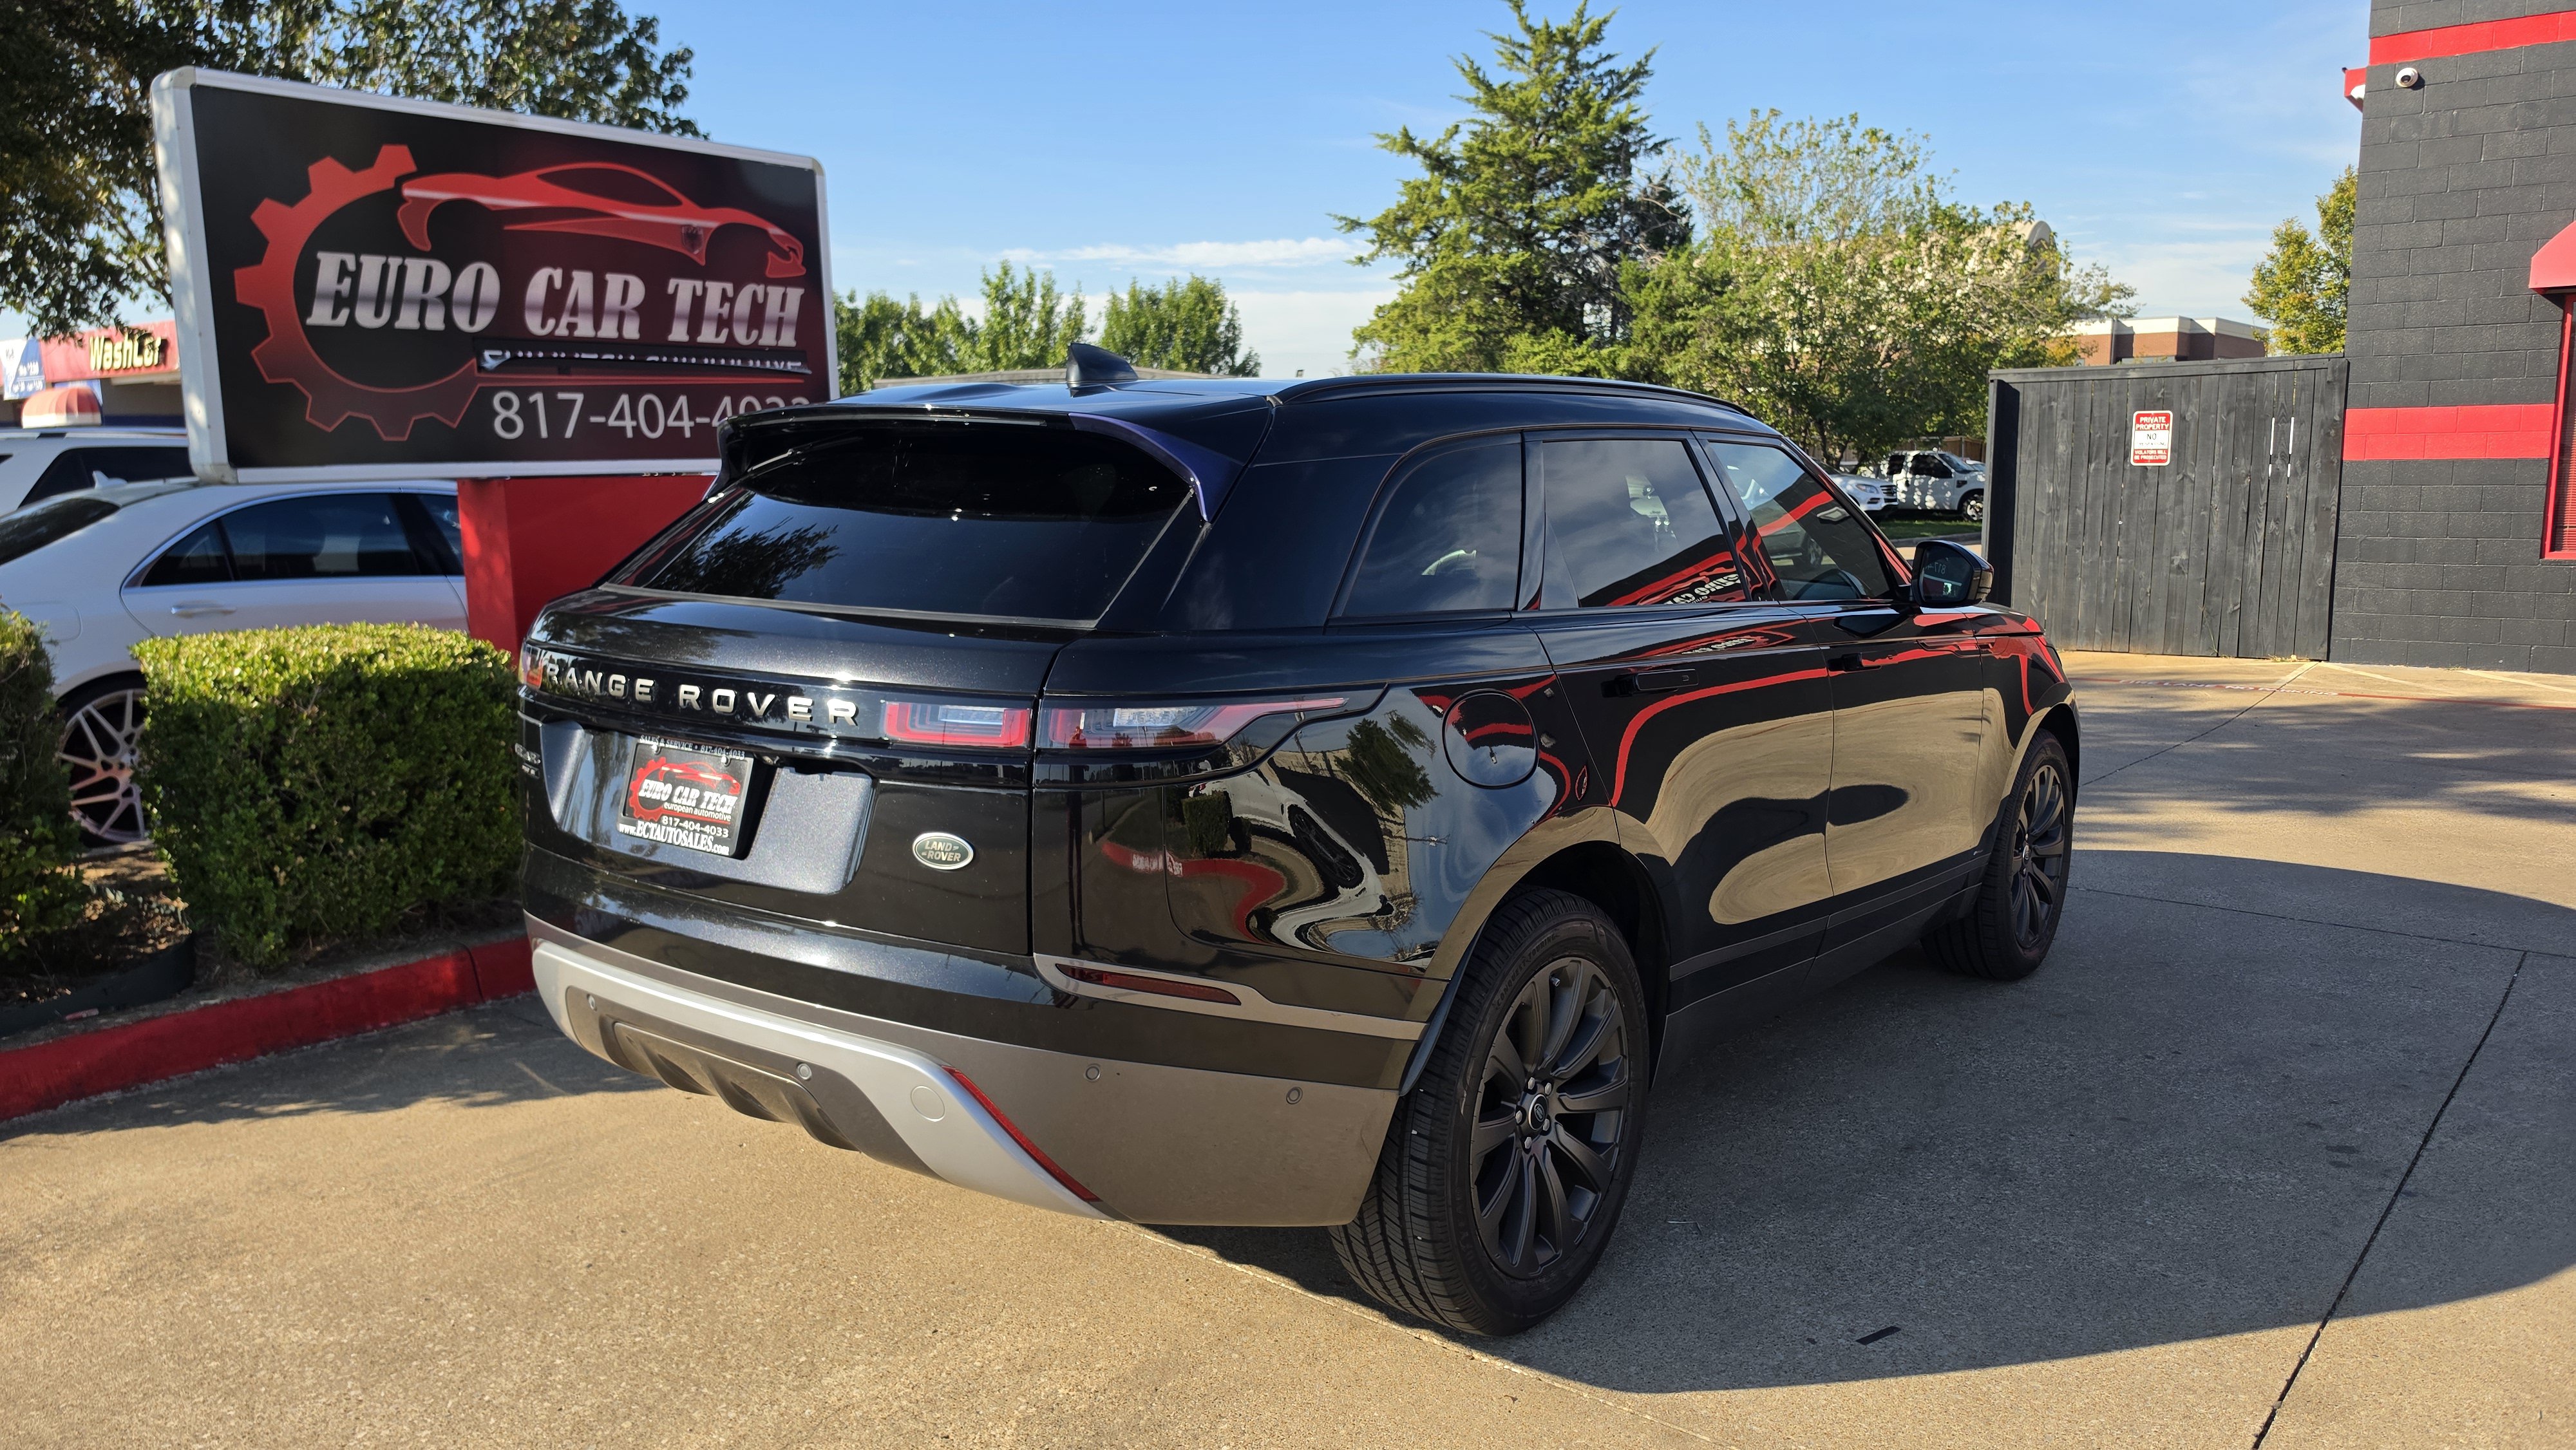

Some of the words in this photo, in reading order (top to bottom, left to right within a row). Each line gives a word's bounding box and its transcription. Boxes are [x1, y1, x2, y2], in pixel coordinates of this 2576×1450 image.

[305, 250, 501, 333] EURO
[524, 266, 646, 339] CAR
[667, 277, 806, 348] TECH
[493, 391, 810, 439] 817-404-4
[547, 663, 656, 701] RANGE
[678, 684, 859, 726] ROVER
[639, 734, 659, 745] SALES
[666, 739, 693, 751] SERVICE
[638, 779, 672, 801] EURO
[673, 786, 699, 807] CAR
[701, 791, 737, 814] TECH
[664, 802, 693, 815] european
[694, 807, 732, 822] automotive
[618, 821, 730, 856] www.ECTAUTOSALES.com
[662, 816, 729, 838] 817-404-4033
[1496, 959, 1528, 1008] CONQUEST
[1528, 933, 1558, 959] TOURING
